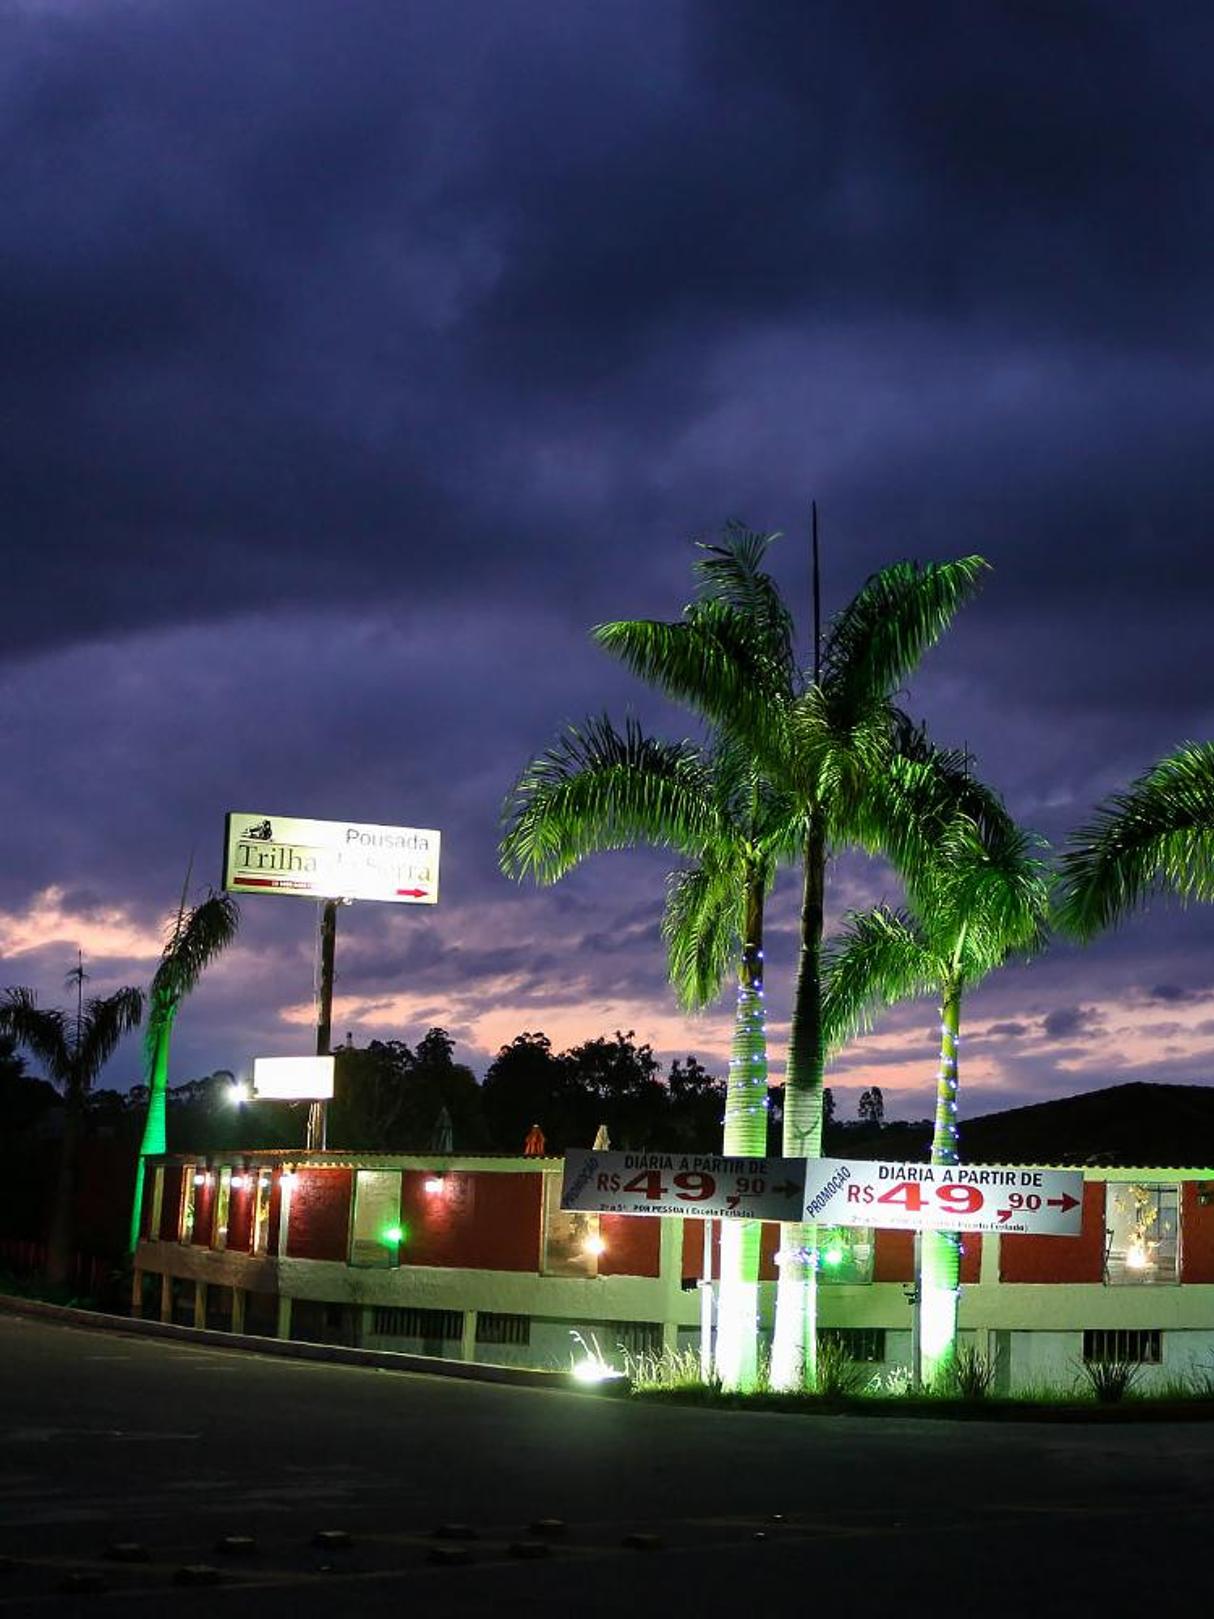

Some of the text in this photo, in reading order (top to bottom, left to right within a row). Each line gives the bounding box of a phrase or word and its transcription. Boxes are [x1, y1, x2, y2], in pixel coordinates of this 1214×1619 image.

[346, 828, 429, 851] Pousada
[238, 844, 317, 873] Trilha
[625, 1153, 768, 1174] DIÁRIA A PARTIR DE
[879, 1164, 1043, 1188] DIÁRIA A PARTIR DE
[806, 1165, 851, 1218] PROMOÇÃO
